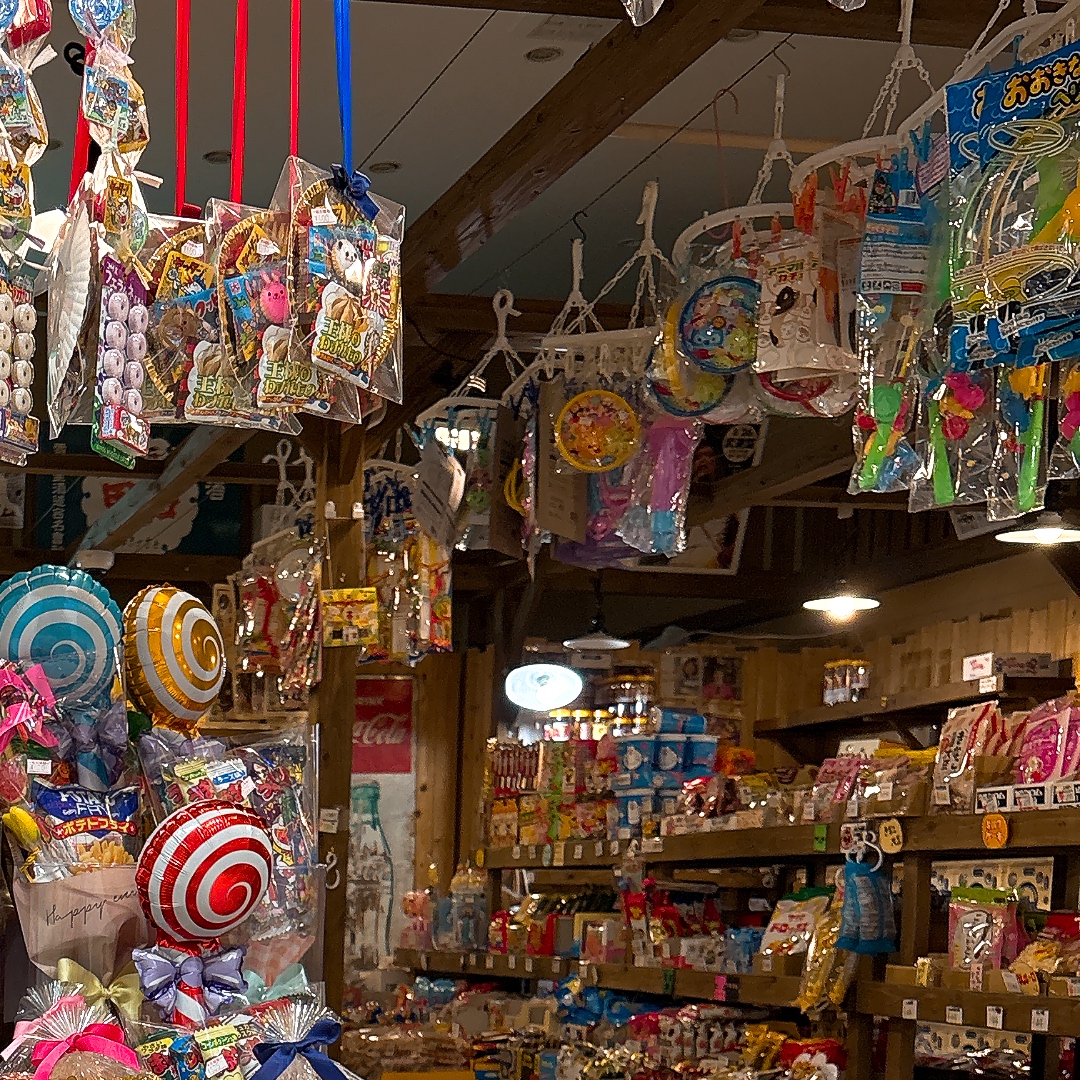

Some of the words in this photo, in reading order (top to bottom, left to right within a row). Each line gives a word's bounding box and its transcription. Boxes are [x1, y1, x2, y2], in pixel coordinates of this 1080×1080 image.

[62, 817, 132, 838] ポテトフライ
